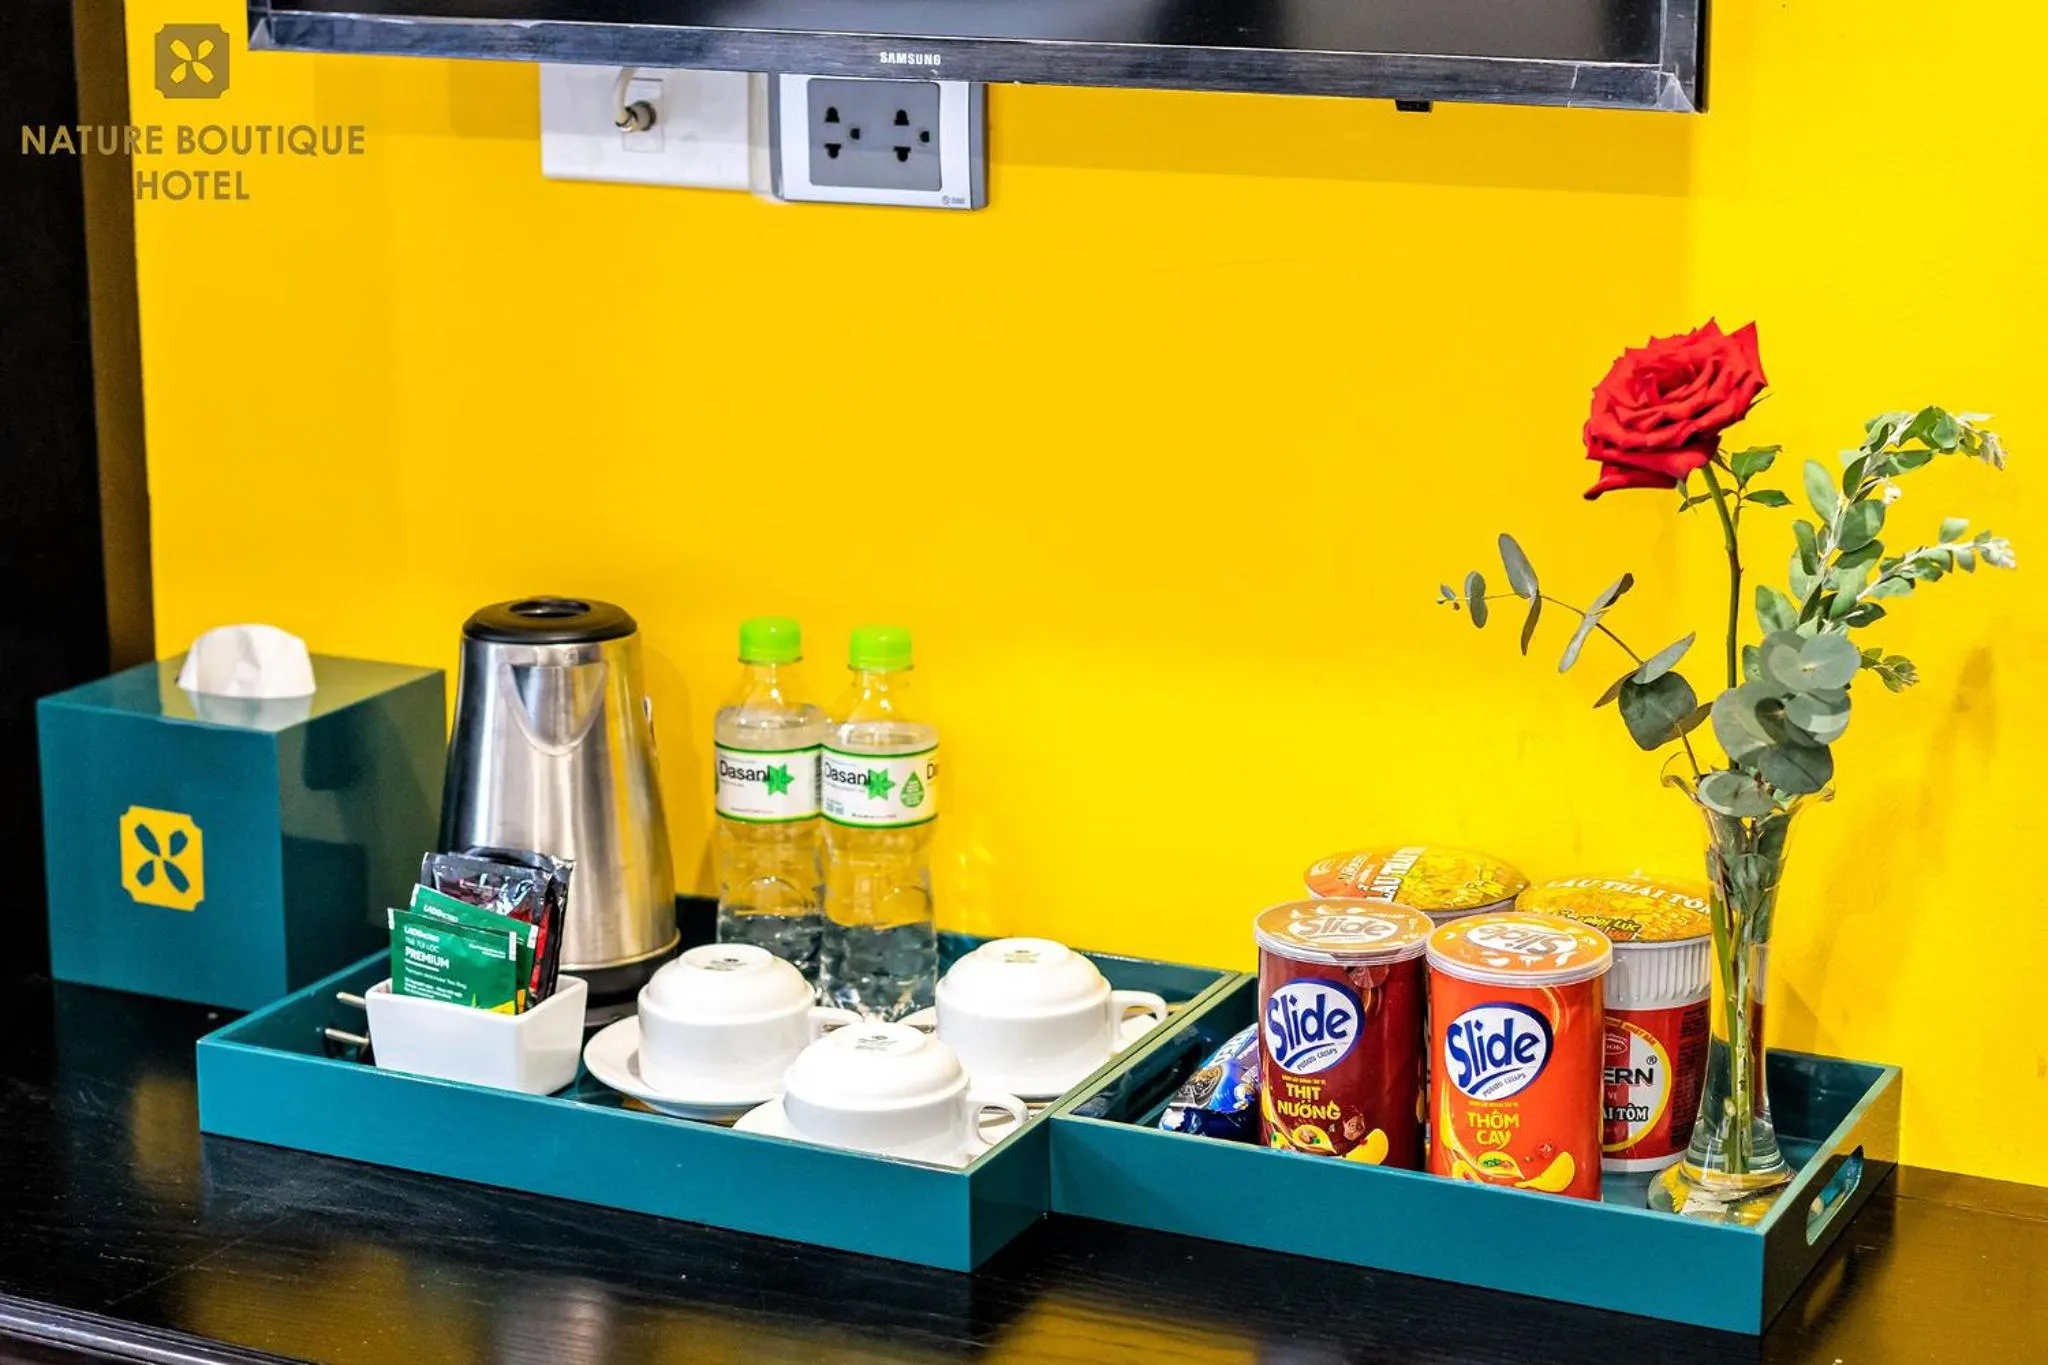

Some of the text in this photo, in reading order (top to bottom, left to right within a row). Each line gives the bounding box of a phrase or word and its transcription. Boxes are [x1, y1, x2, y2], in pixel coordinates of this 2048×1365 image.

[880, 51, 941, 66] SAMSUNG
[1298, 917, 1391, 936] Slide
[405, 946, 450, 969] PREMIUM
[1267, 994, 1351, 1061] Slide
[1447, 1018, 1540, 1088] Slide
[1616, 1103, 1648, 1121] TÔM
[1476, 1129, 1512, 1150] CAY
